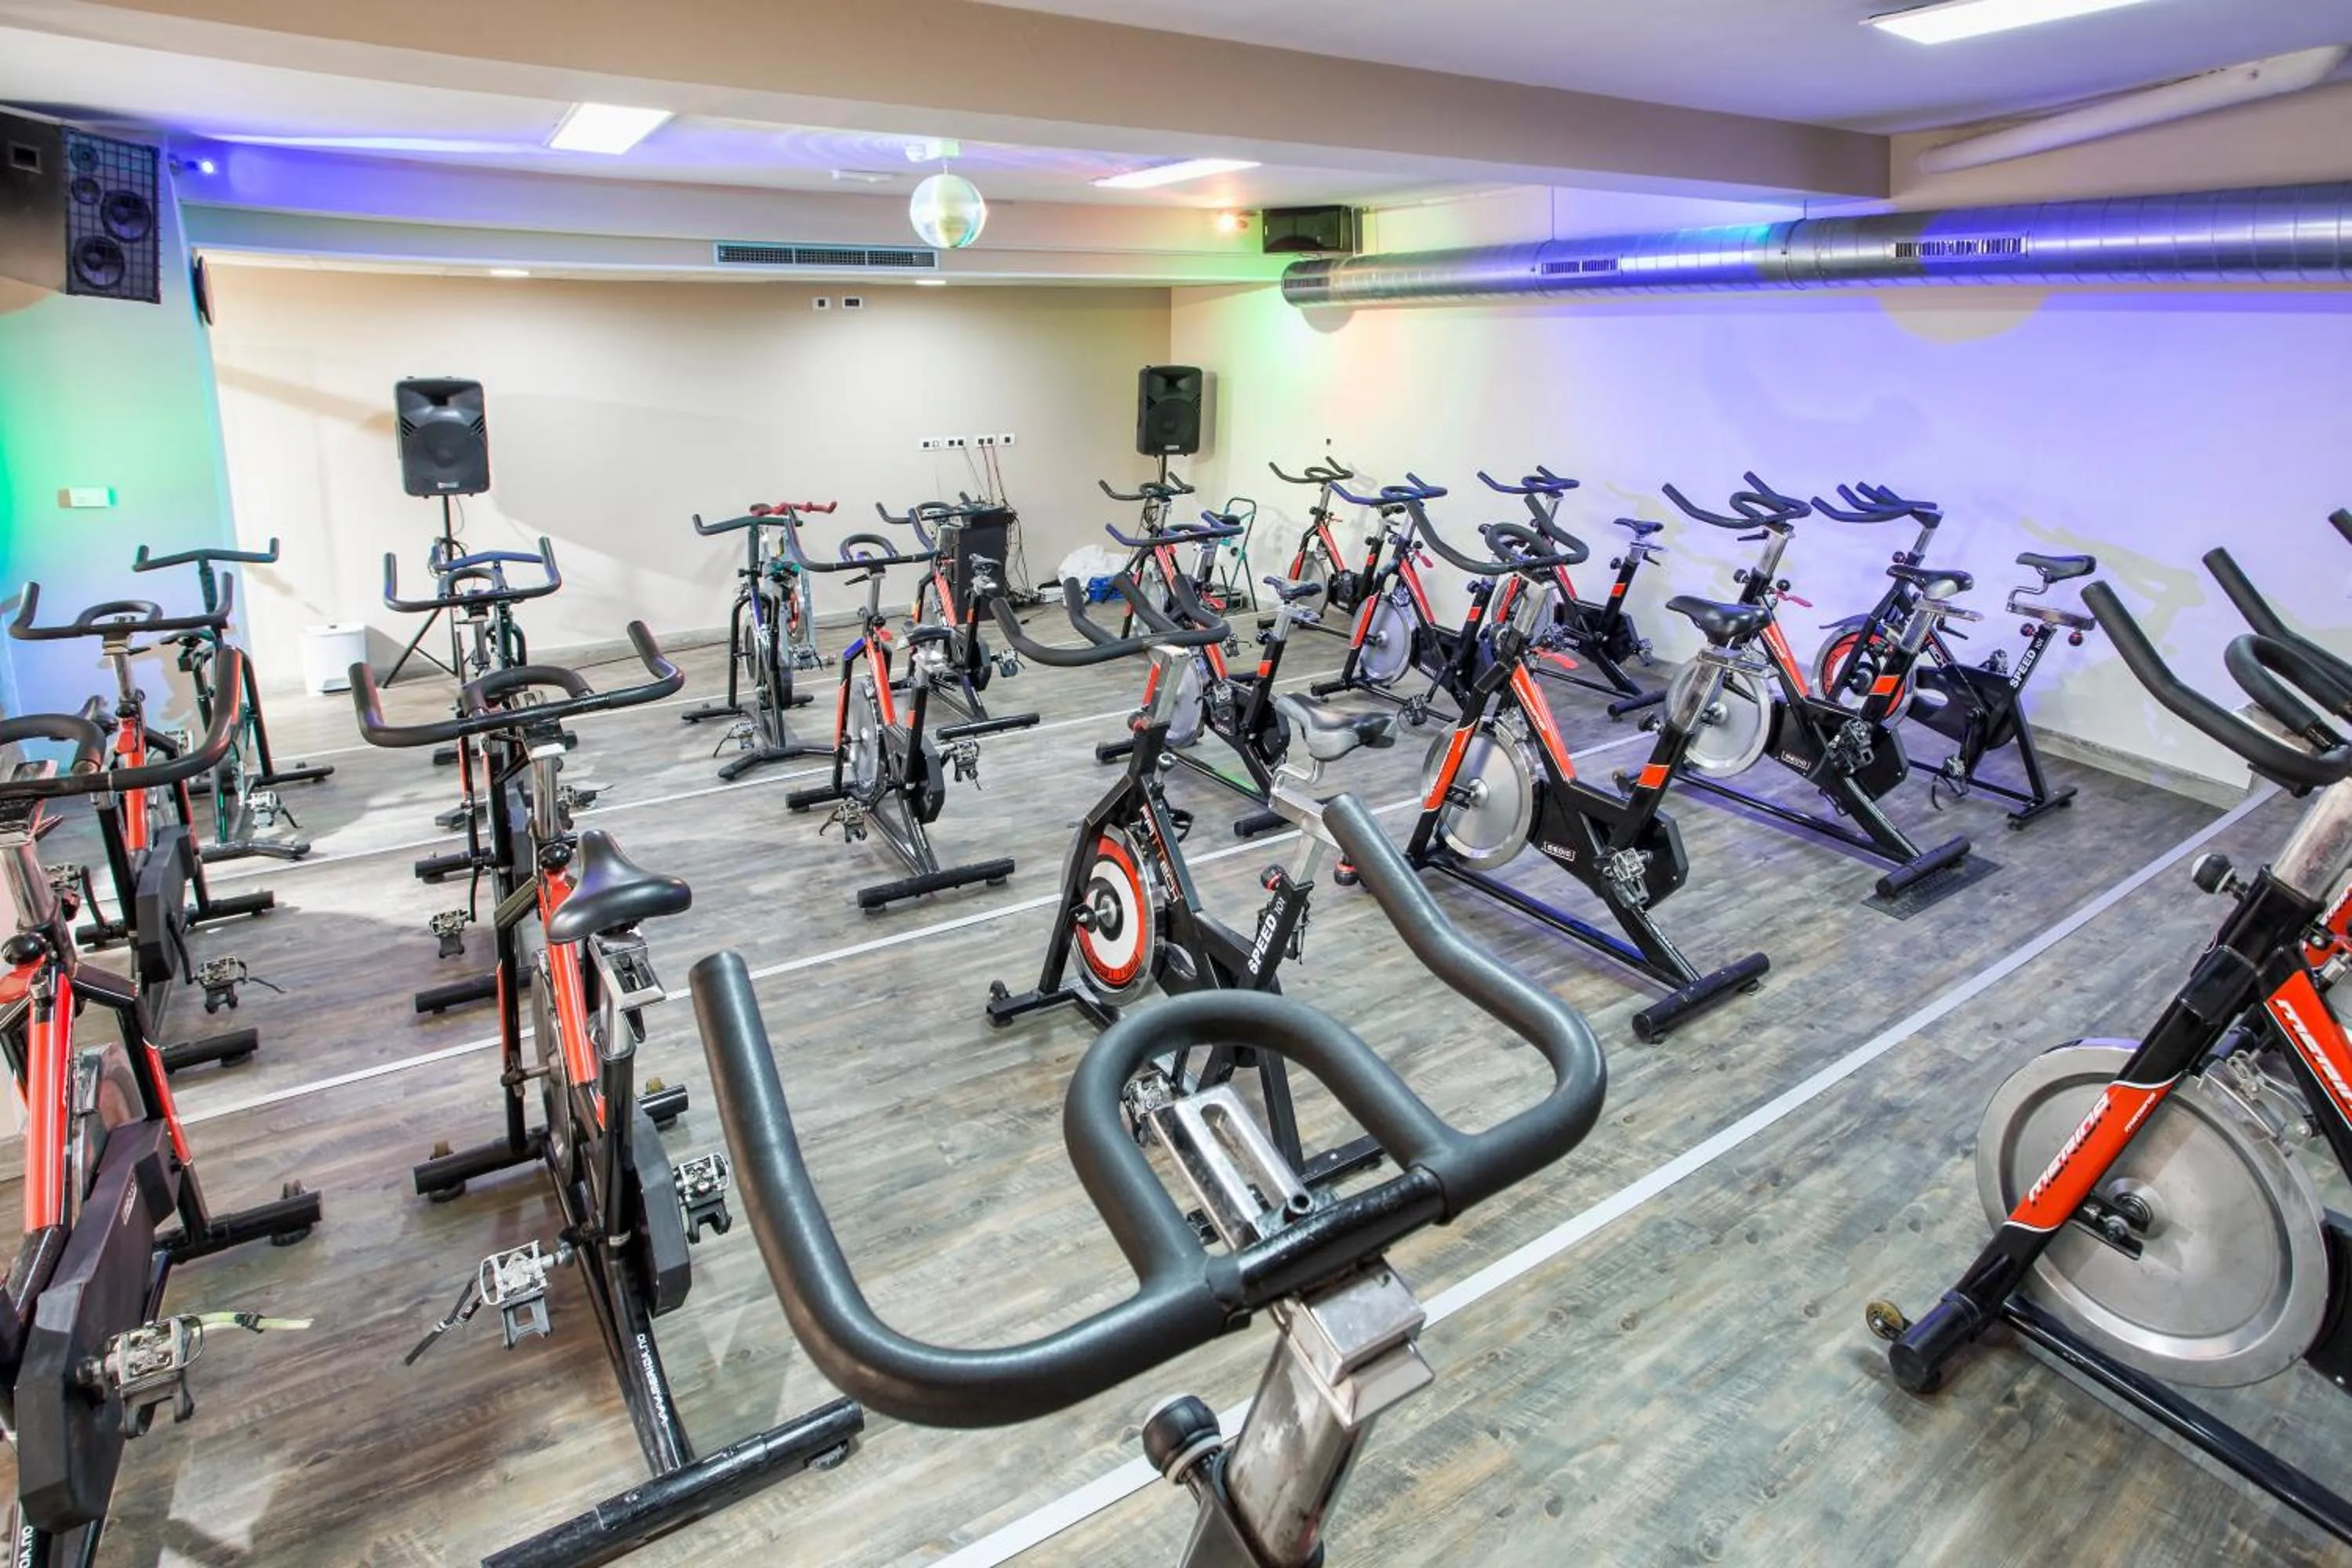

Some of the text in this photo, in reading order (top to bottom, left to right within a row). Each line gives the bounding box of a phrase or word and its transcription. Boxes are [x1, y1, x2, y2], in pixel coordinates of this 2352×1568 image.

[2009, 649, 2037, 688] SPEED
[1247, 913, 1277, 975] SPEED
[2028, 1091, 2111, 1203] MERIDA
